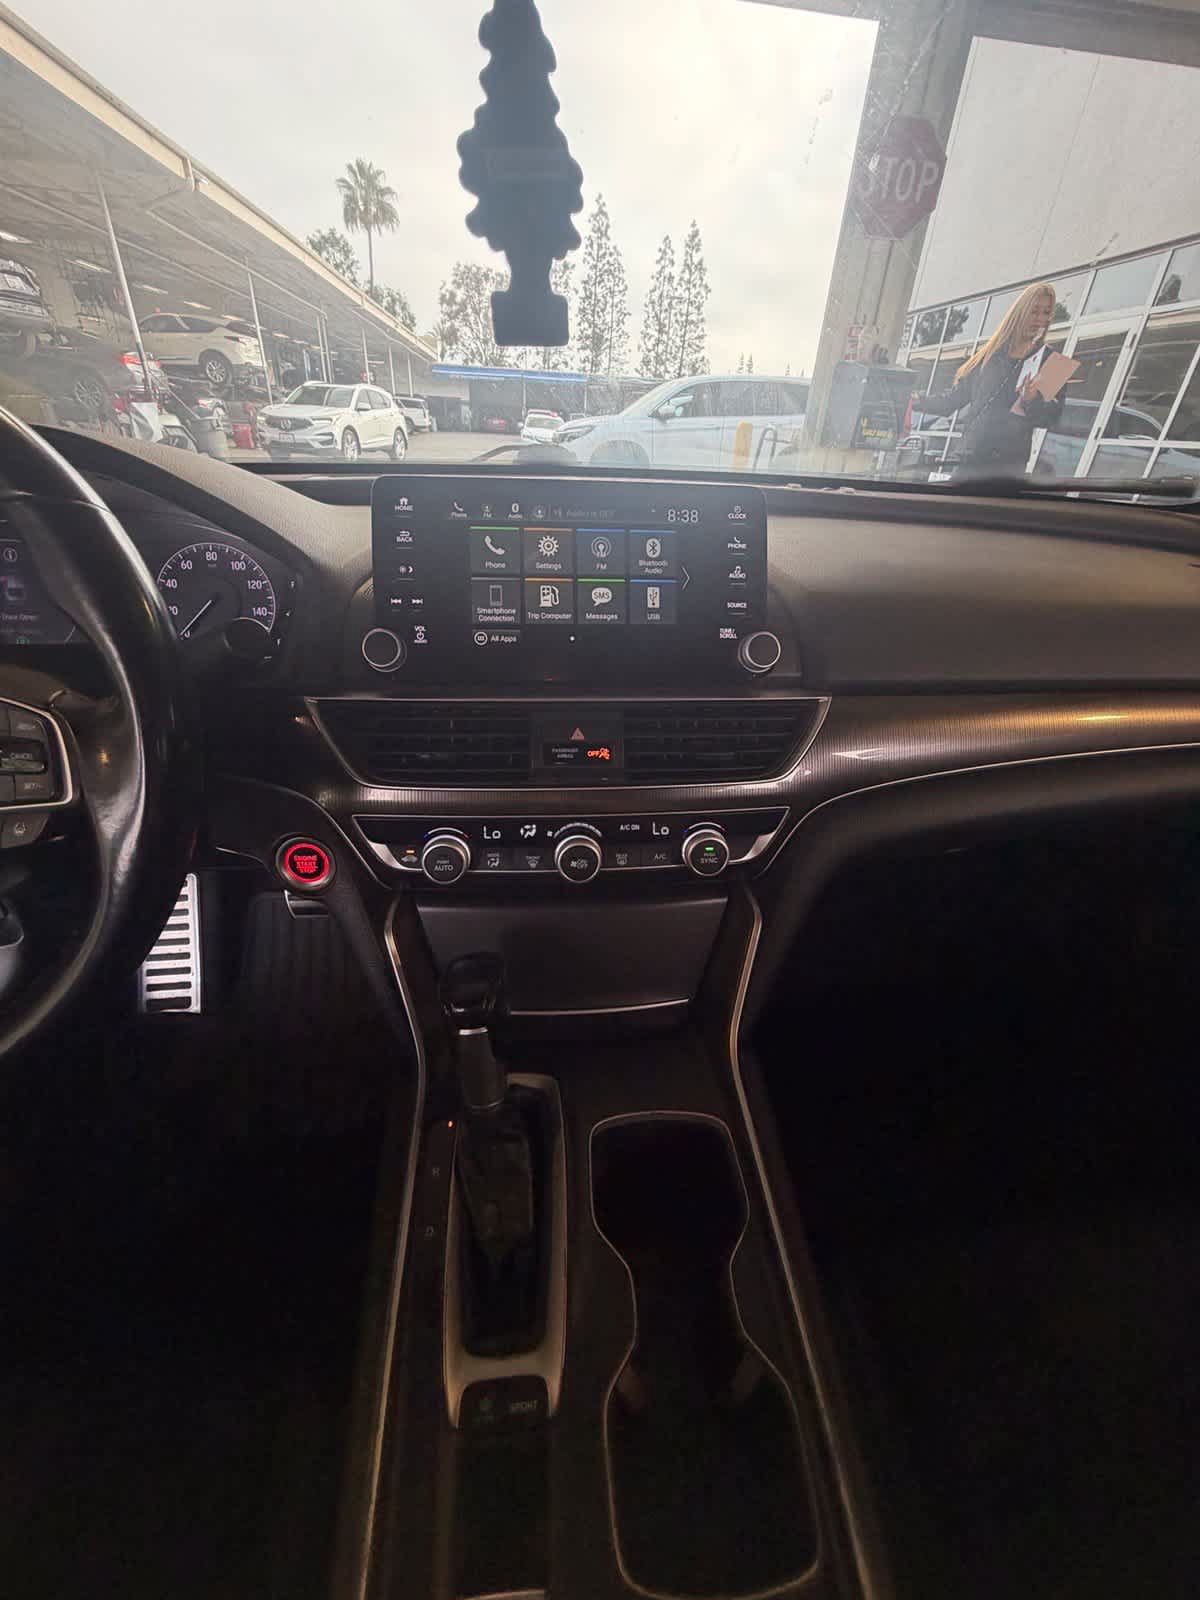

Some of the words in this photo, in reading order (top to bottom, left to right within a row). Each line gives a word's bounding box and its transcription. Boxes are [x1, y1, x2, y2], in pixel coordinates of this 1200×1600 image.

[856, 157, 940, 204] STOP
[394, 504, 414, 512] HOME
[667, 509, 699, 523] 8:38
[727, 512, 747, 520] CLOCK
[205, 552, 218, 561] 80
[180, 560, 193, 570] 60
[231, 561, 246, 570] 100
[485, 561, 506, 569] Phone
[535, 561, 562, 571] Settings
[638, 559, 669, 567] Bluetooth
[165, 579, 178, 589] 40
[247, 580, 262, 589] 120
[593, 591, 610, 600] SMS
[252, 607, 268, 616] 140
[477, 607, 516, 615] Smartphone
[478, 614, 515, 622] Connection
[527, 612, 540, 620] Trip
[541, 612, 572, 620] Computer
[585, 612, 618, 621] Messages
[500, 635, 517, 643] Apps
[483, 825, 502, 840] Lo
[652, 821, 670, 836] Lo
